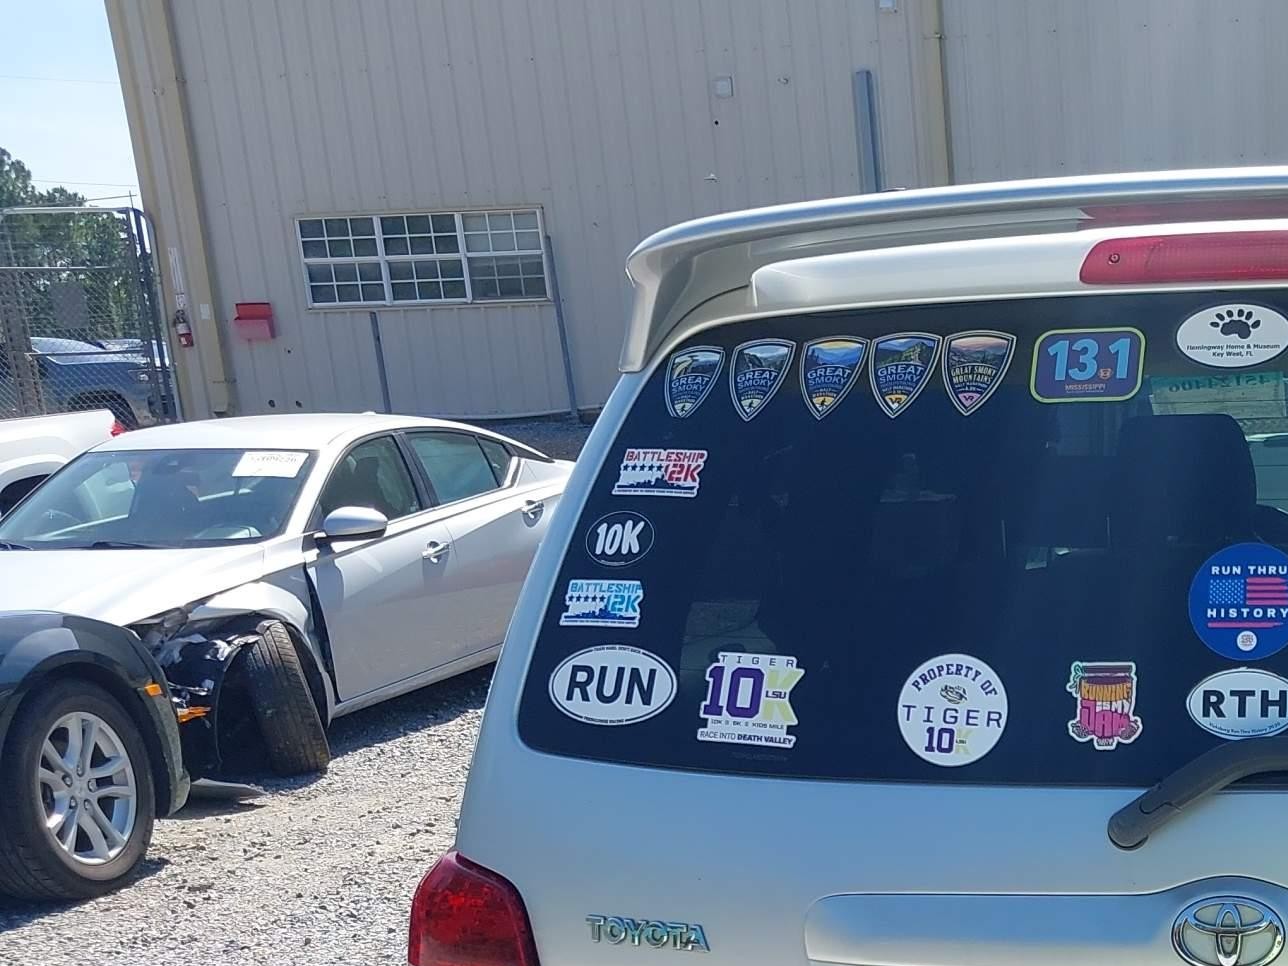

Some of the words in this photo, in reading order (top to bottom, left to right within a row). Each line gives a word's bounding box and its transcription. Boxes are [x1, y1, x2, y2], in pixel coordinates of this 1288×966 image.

[737, 370, 778, 383] GREAT
[807, 367, 851, 379] GREAT
[878, 365, 925, 377] GREAT
[951, 366, 972, 377] GREAT
[974, 365, 997, 377] SMOKY
[671, 375, 710, 387] GREAT
[737, 379, 774, 390] SMOKY
[808, 375, 848, 386] SMOKY
[879, 373, 921, 384] SMOKY
[952, 374, 993, 385] MOUNTAINS
[626, 451, 705, 463] BATTLESHIP
[595, 520, 645, 555] 10K
[1211, 566, 1242, 575] RUN
[1248, 566, 1288, 575] THRU
[570, 582, 642, 594] BATTLESHIP
[1207, 608, 1288, 618] HISTORY
[721, 654, 795, 668] TIGER
[566, 664, 657, 706] RUN
[912, 664, 982, 692] PROPERTY
[980, 680, 998, 696] OF
[702, 666, 804, 722] 10K
[765, 690, 787, 699] LSU
[1080, 682, 1131, 702] RUNNING
[1111, 699, 1130, 714] MY
[1202, 689, 1288, 718] RTH
[902, 704, 1002, 728] TIGER
[1081, 700, 1130, 738] JAM
[700, 731, 718, 739] RACE
[719, 732, 736, 741] INTO
[737, 734, 762, 743] DEATH
[763, 735, 793, 745] VALLEY
[586, 914, 711, 952] TOYOTA
